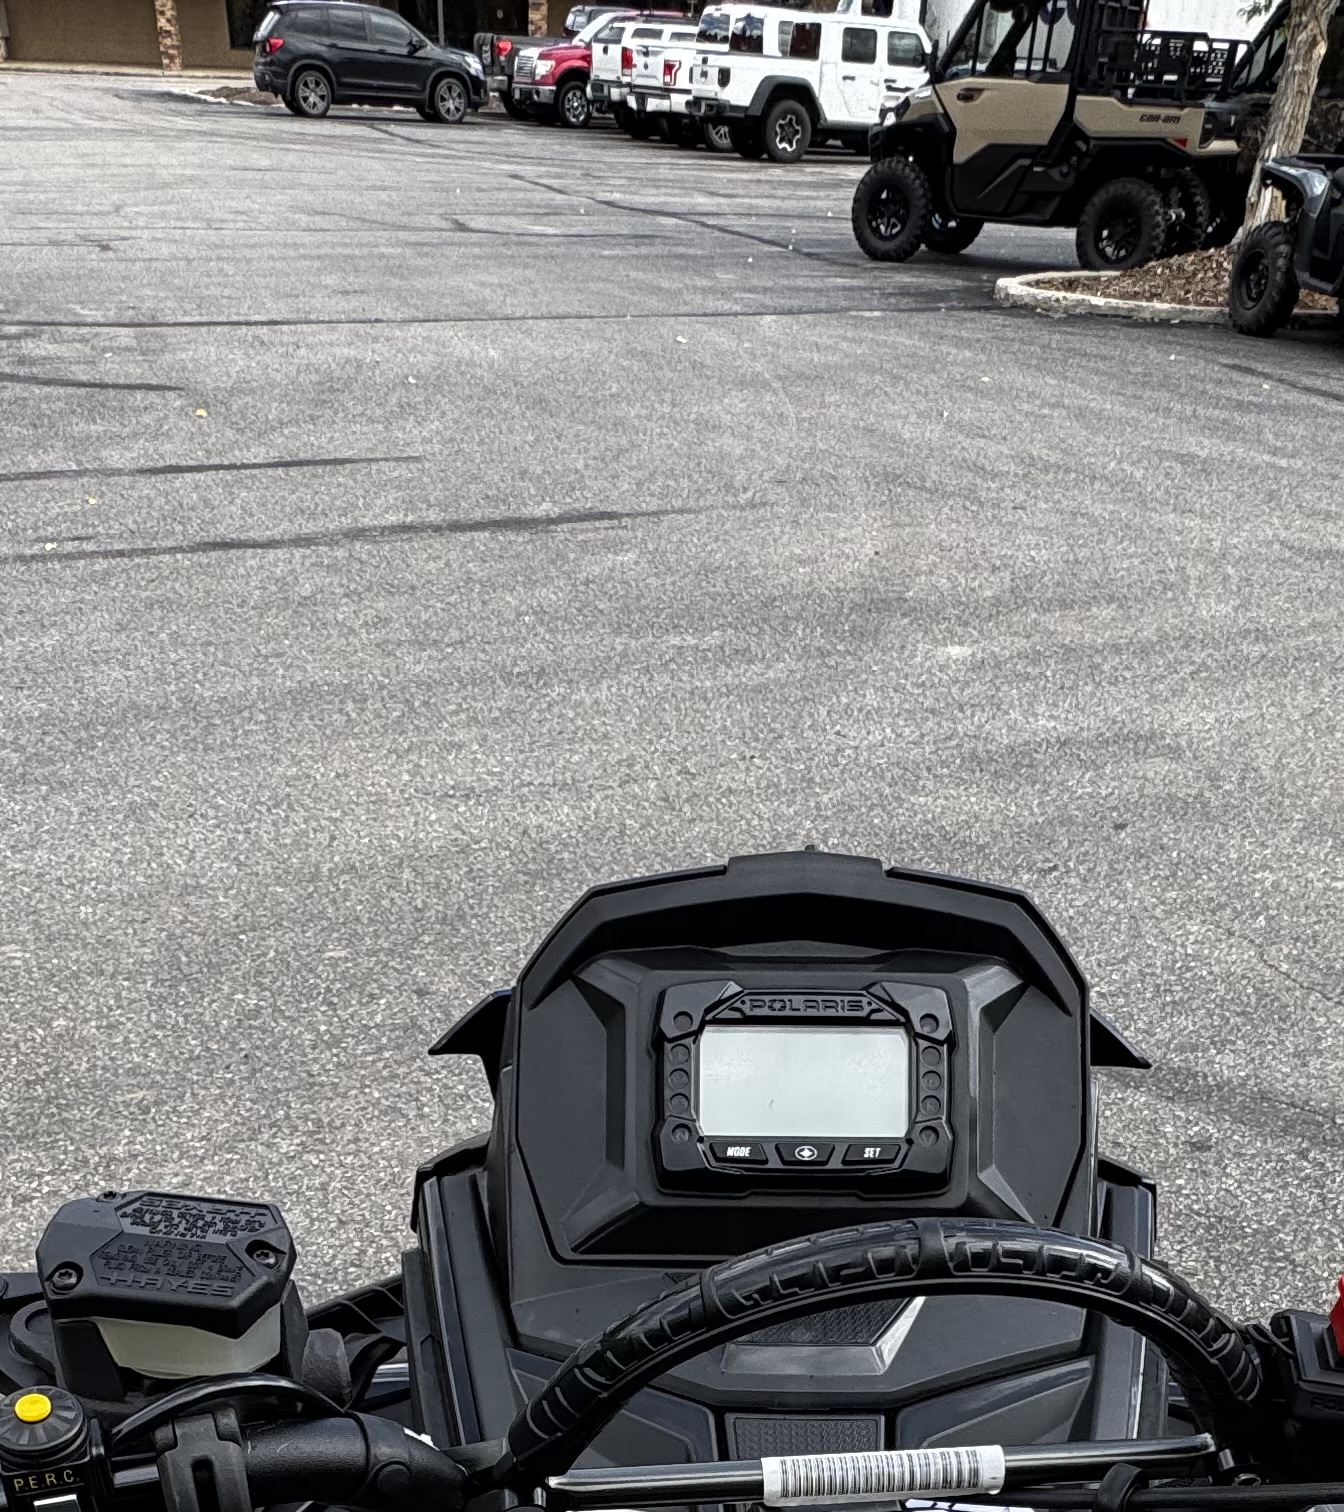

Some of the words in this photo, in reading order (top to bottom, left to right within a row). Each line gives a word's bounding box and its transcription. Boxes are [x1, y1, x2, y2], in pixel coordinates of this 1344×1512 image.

[749, 999, 865, 1013] POLARIS
[726, 1146, 751, 1157] MODE
[863, 1147, 881, 1158] SET
[99, 1273, 235, 1297] HAYES
[14, 1470, 80, 1491] P.E.R.C.
